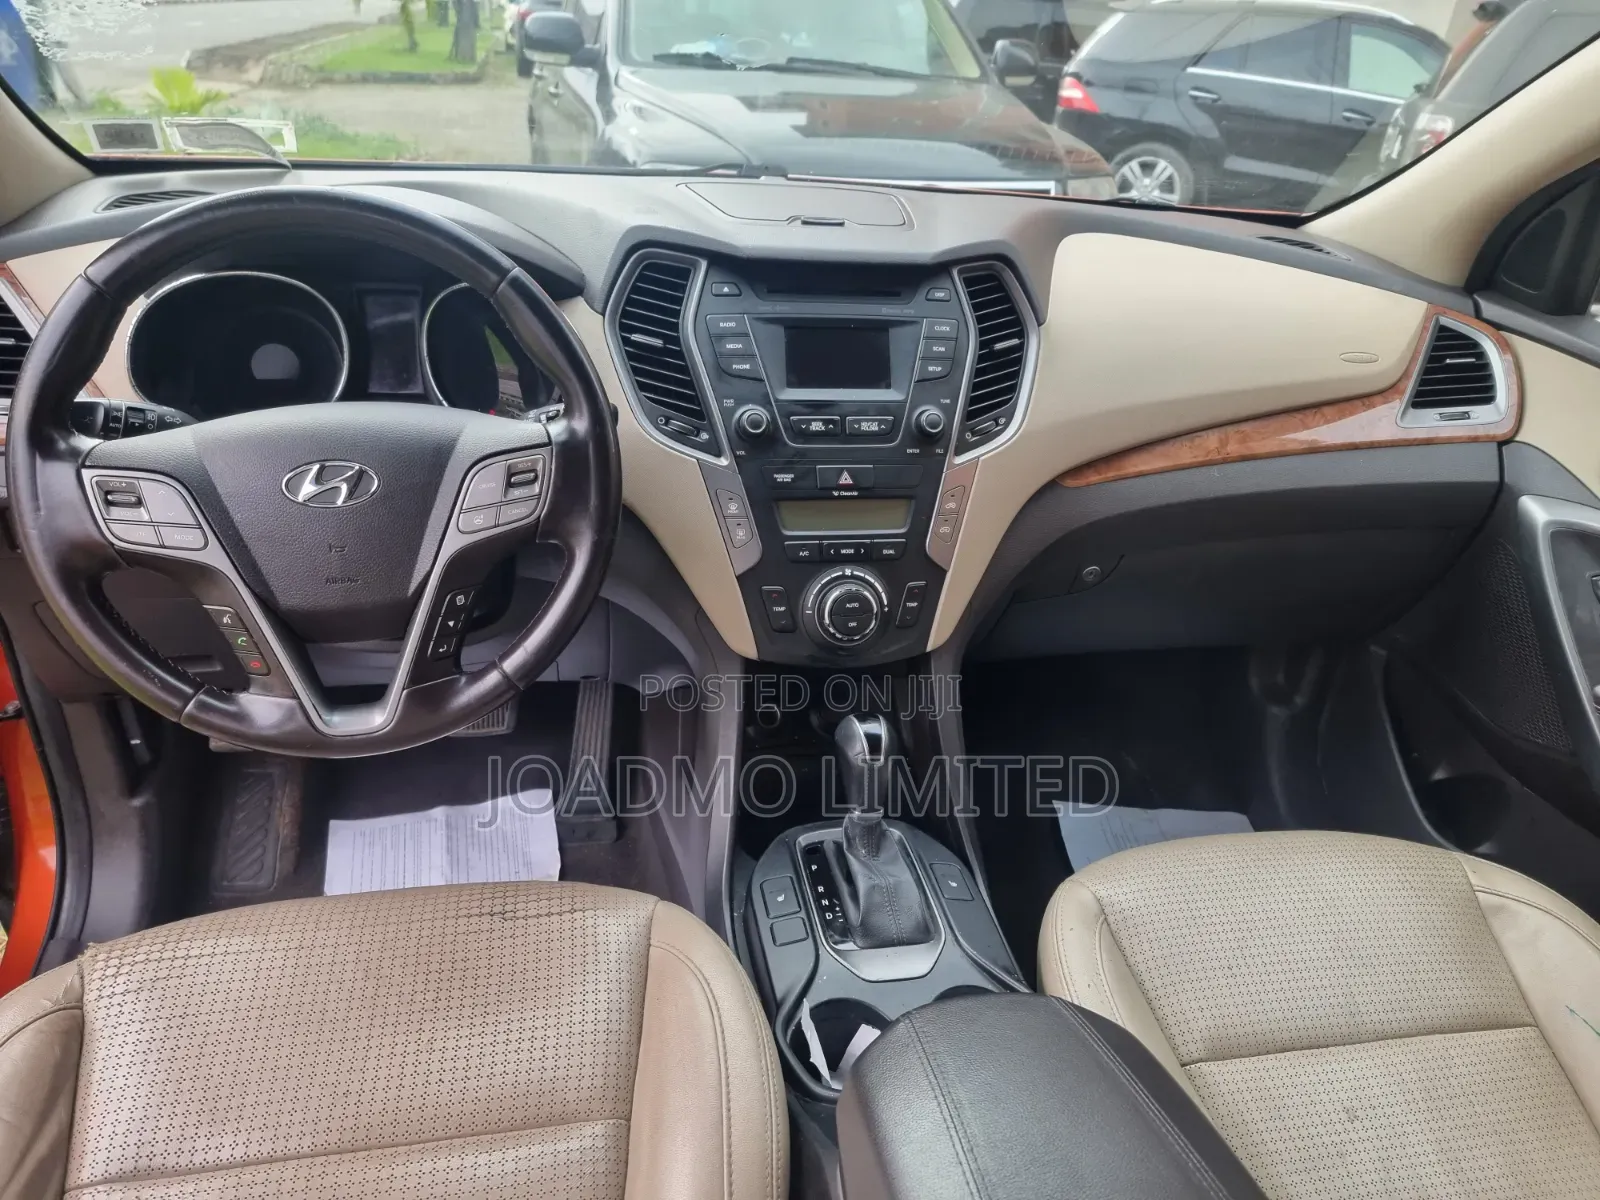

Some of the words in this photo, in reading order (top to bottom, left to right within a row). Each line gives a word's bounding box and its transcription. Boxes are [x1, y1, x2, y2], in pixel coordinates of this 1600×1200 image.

[817, 885, 825, 893] R
[821, 898, 830, 906] N
[825, 912, 833, 920] D
